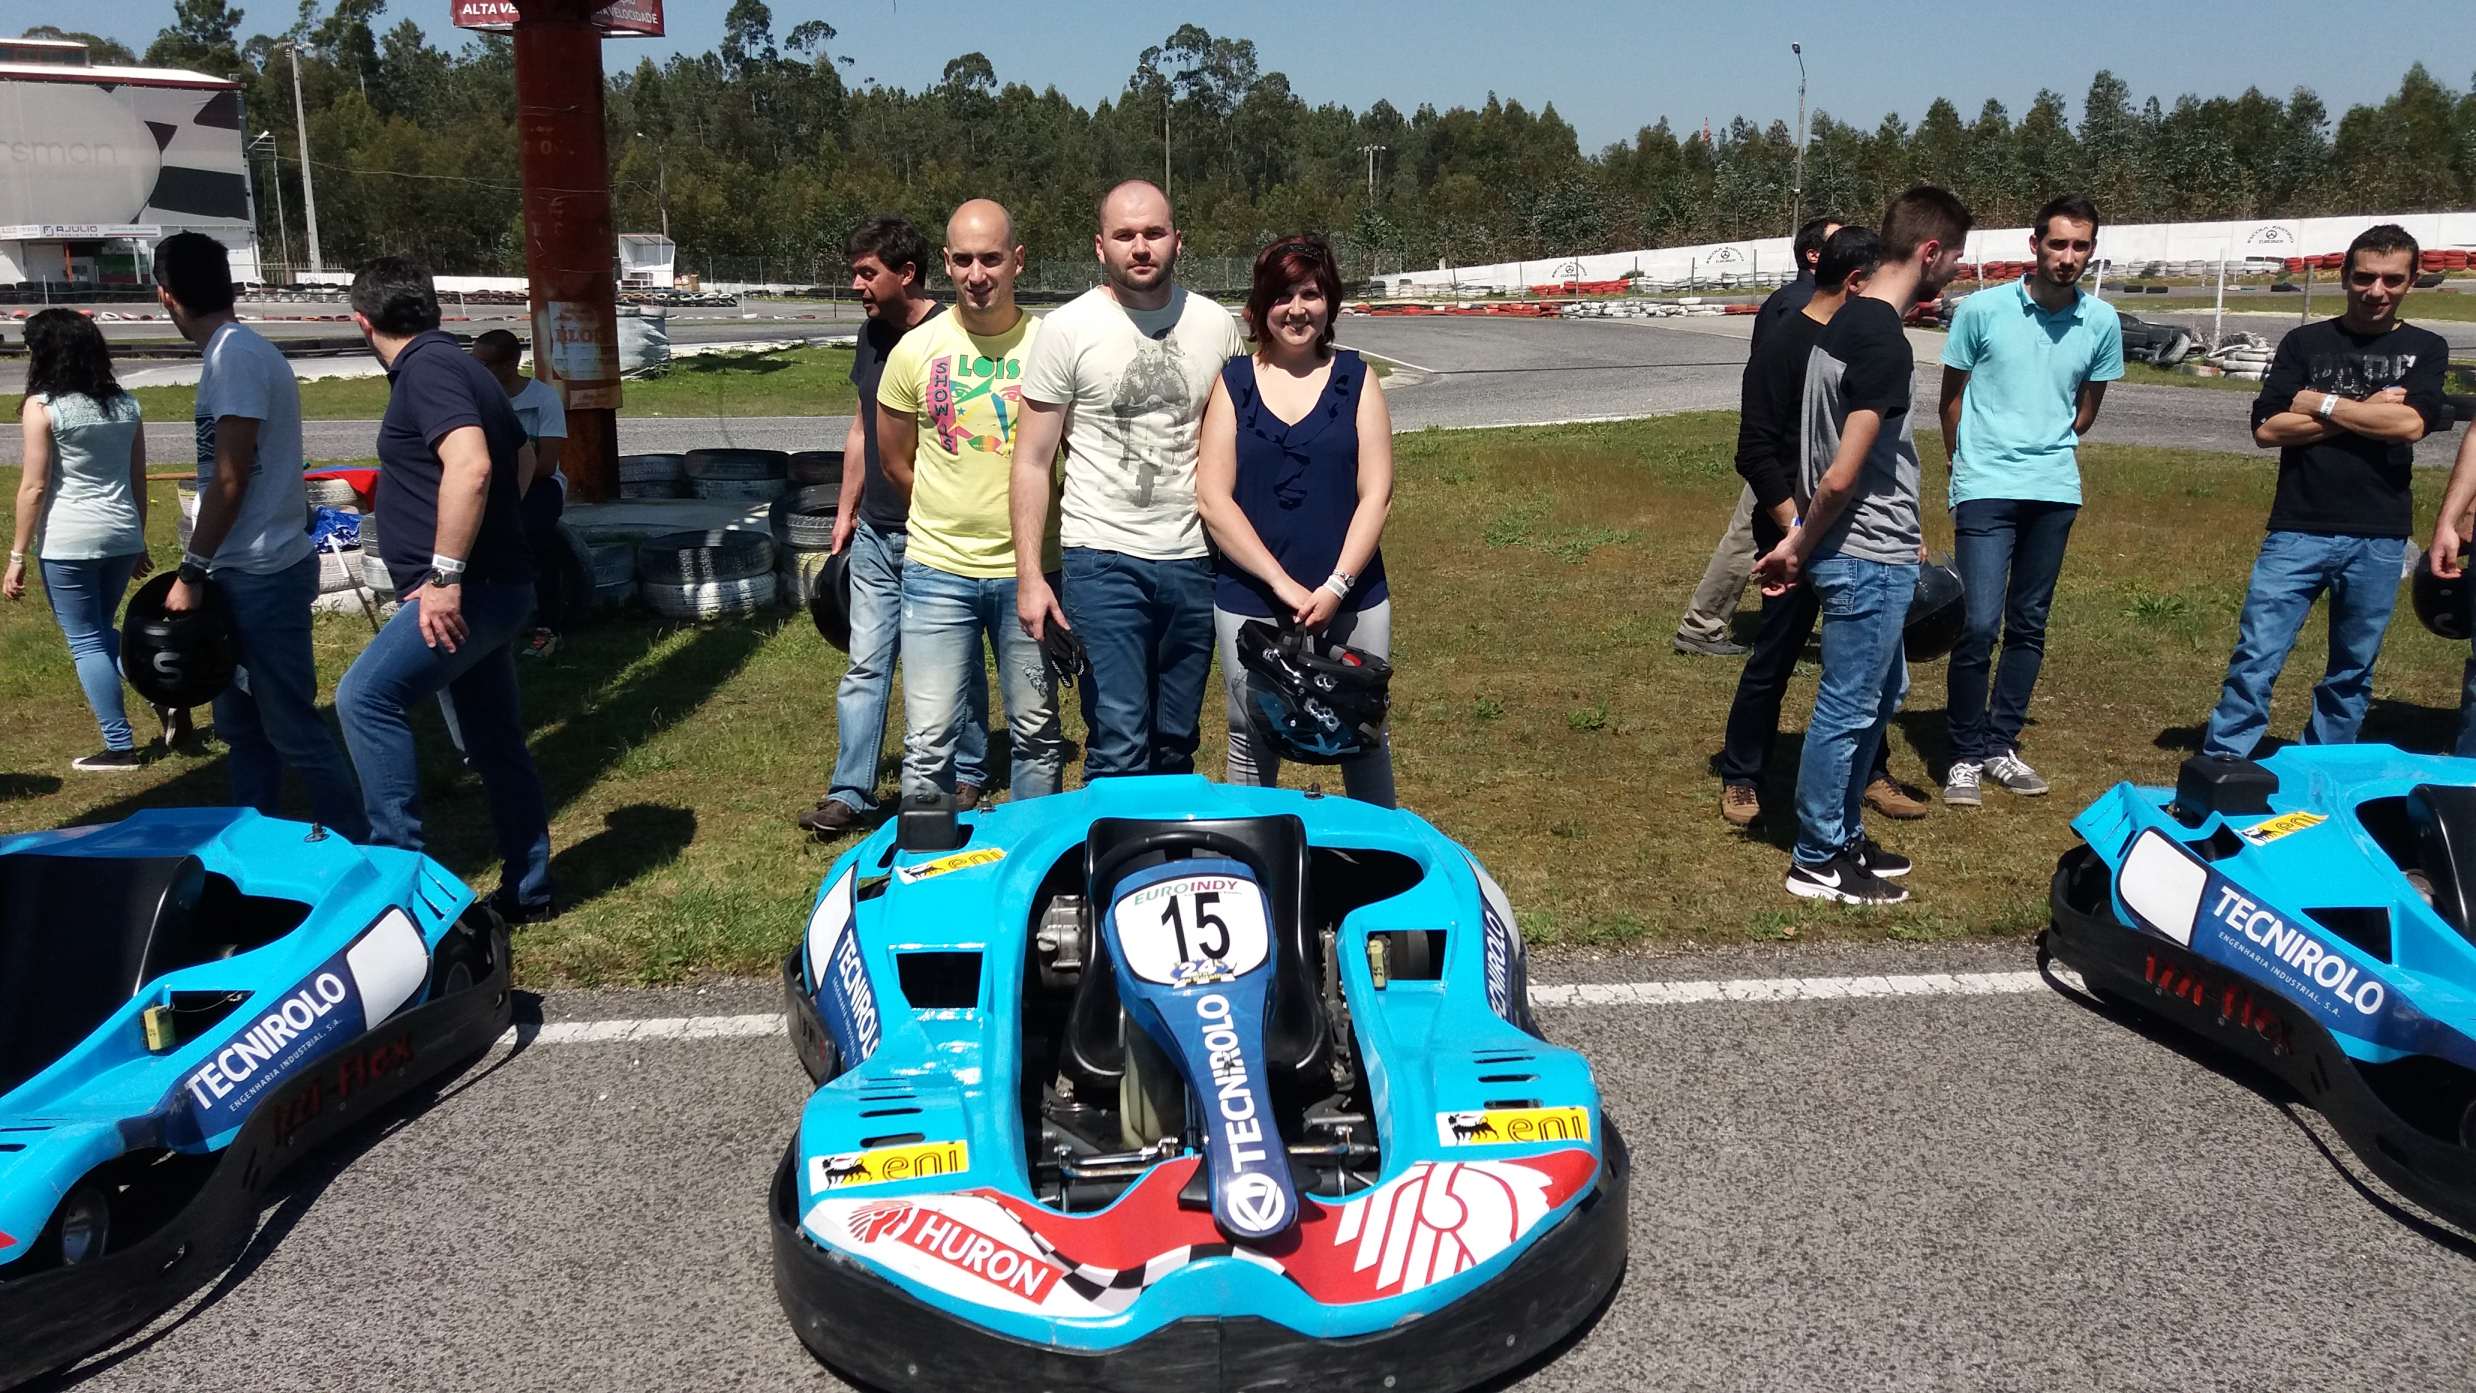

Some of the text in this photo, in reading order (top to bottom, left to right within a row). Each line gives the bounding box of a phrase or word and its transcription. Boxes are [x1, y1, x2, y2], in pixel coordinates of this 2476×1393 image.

[463, 3, 497, 15] ALTA
[958, 355, 1020, 379] LOIS
[1134, 880, 1238, 906] EUROINDY
[1161, 891, 1230, 963] 15
[2213, 886, 2384, 1015] TECNIROLO
[2218, 931, 2269, 969] ENGENHARIA
[184, 972, 347, 1110] TECNIROLO
[229, 1068, 280, 1112] ENGENHARIA
[1197, 993, 1267, 1174] TECNIROLO
[1507, 1107, 1583, 1142] eni
[882, 1141, 958, 1180] eni
[914, 1214, 1049, 1297] HURON
